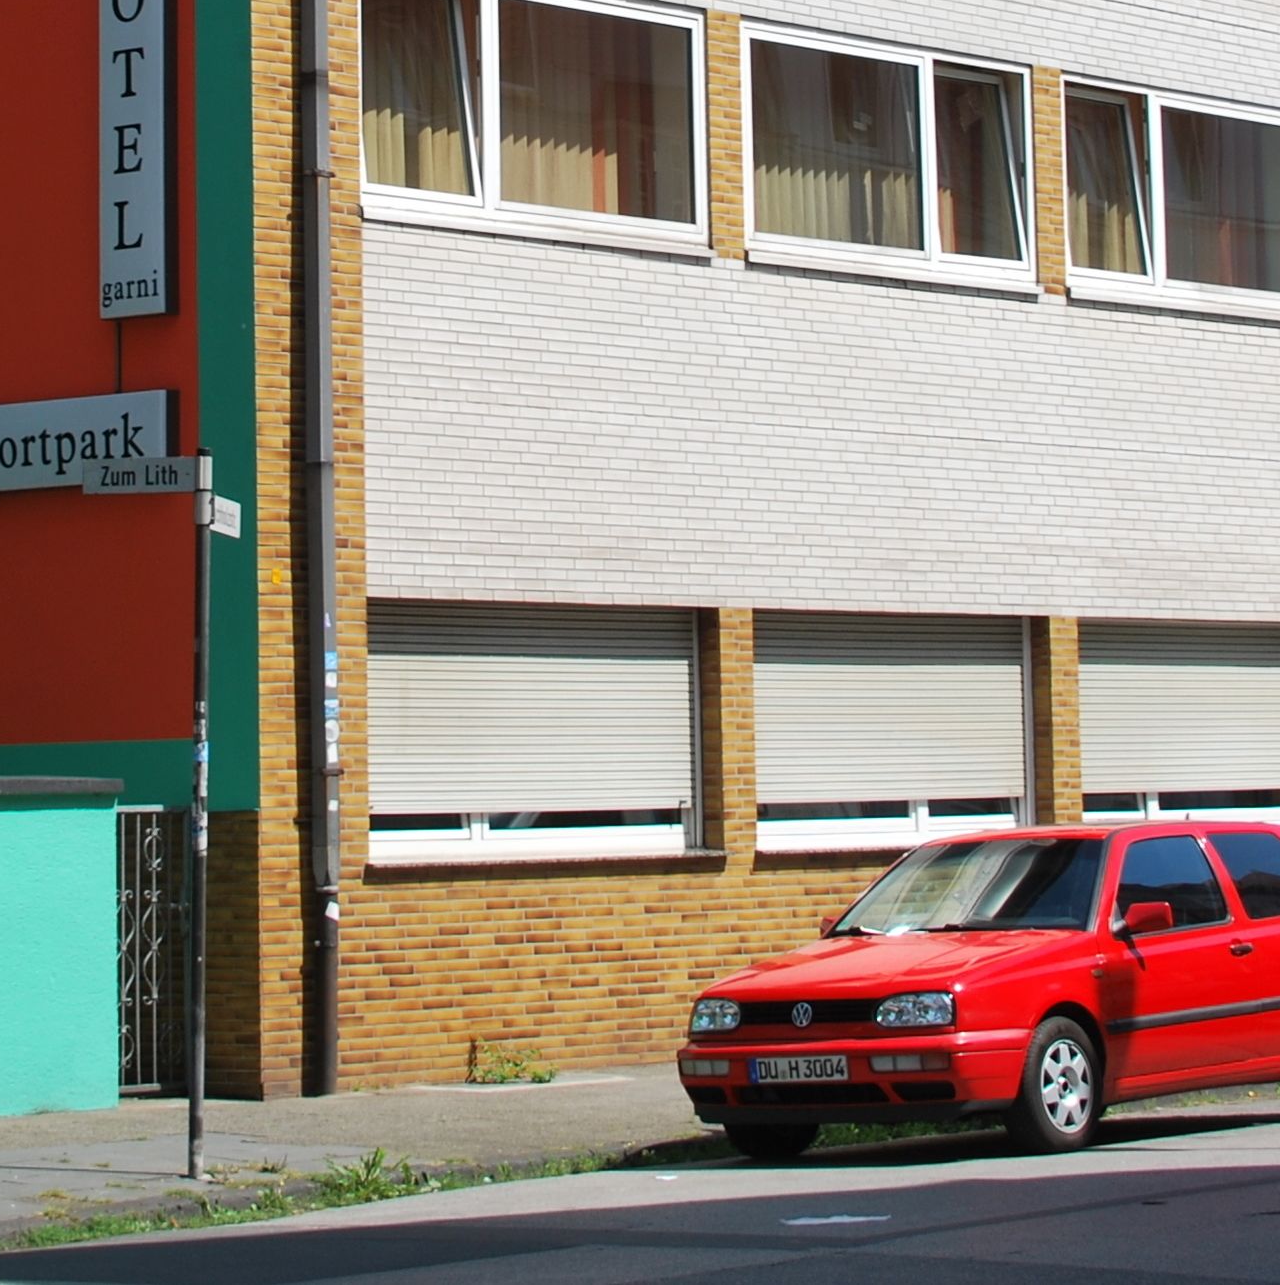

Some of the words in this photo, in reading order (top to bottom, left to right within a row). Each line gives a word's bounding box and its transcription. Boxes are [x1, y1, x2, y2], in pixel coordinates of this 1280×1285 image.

[102, 269, 159, 308] garni
[100, 466, 136, 487] Zum
[145, 464, 178, 486] Lith
[758, 1060, 779, 1080] DU
[788, 1059, 800, 1079] H
[803, 1058, 845, 1079] 3004
